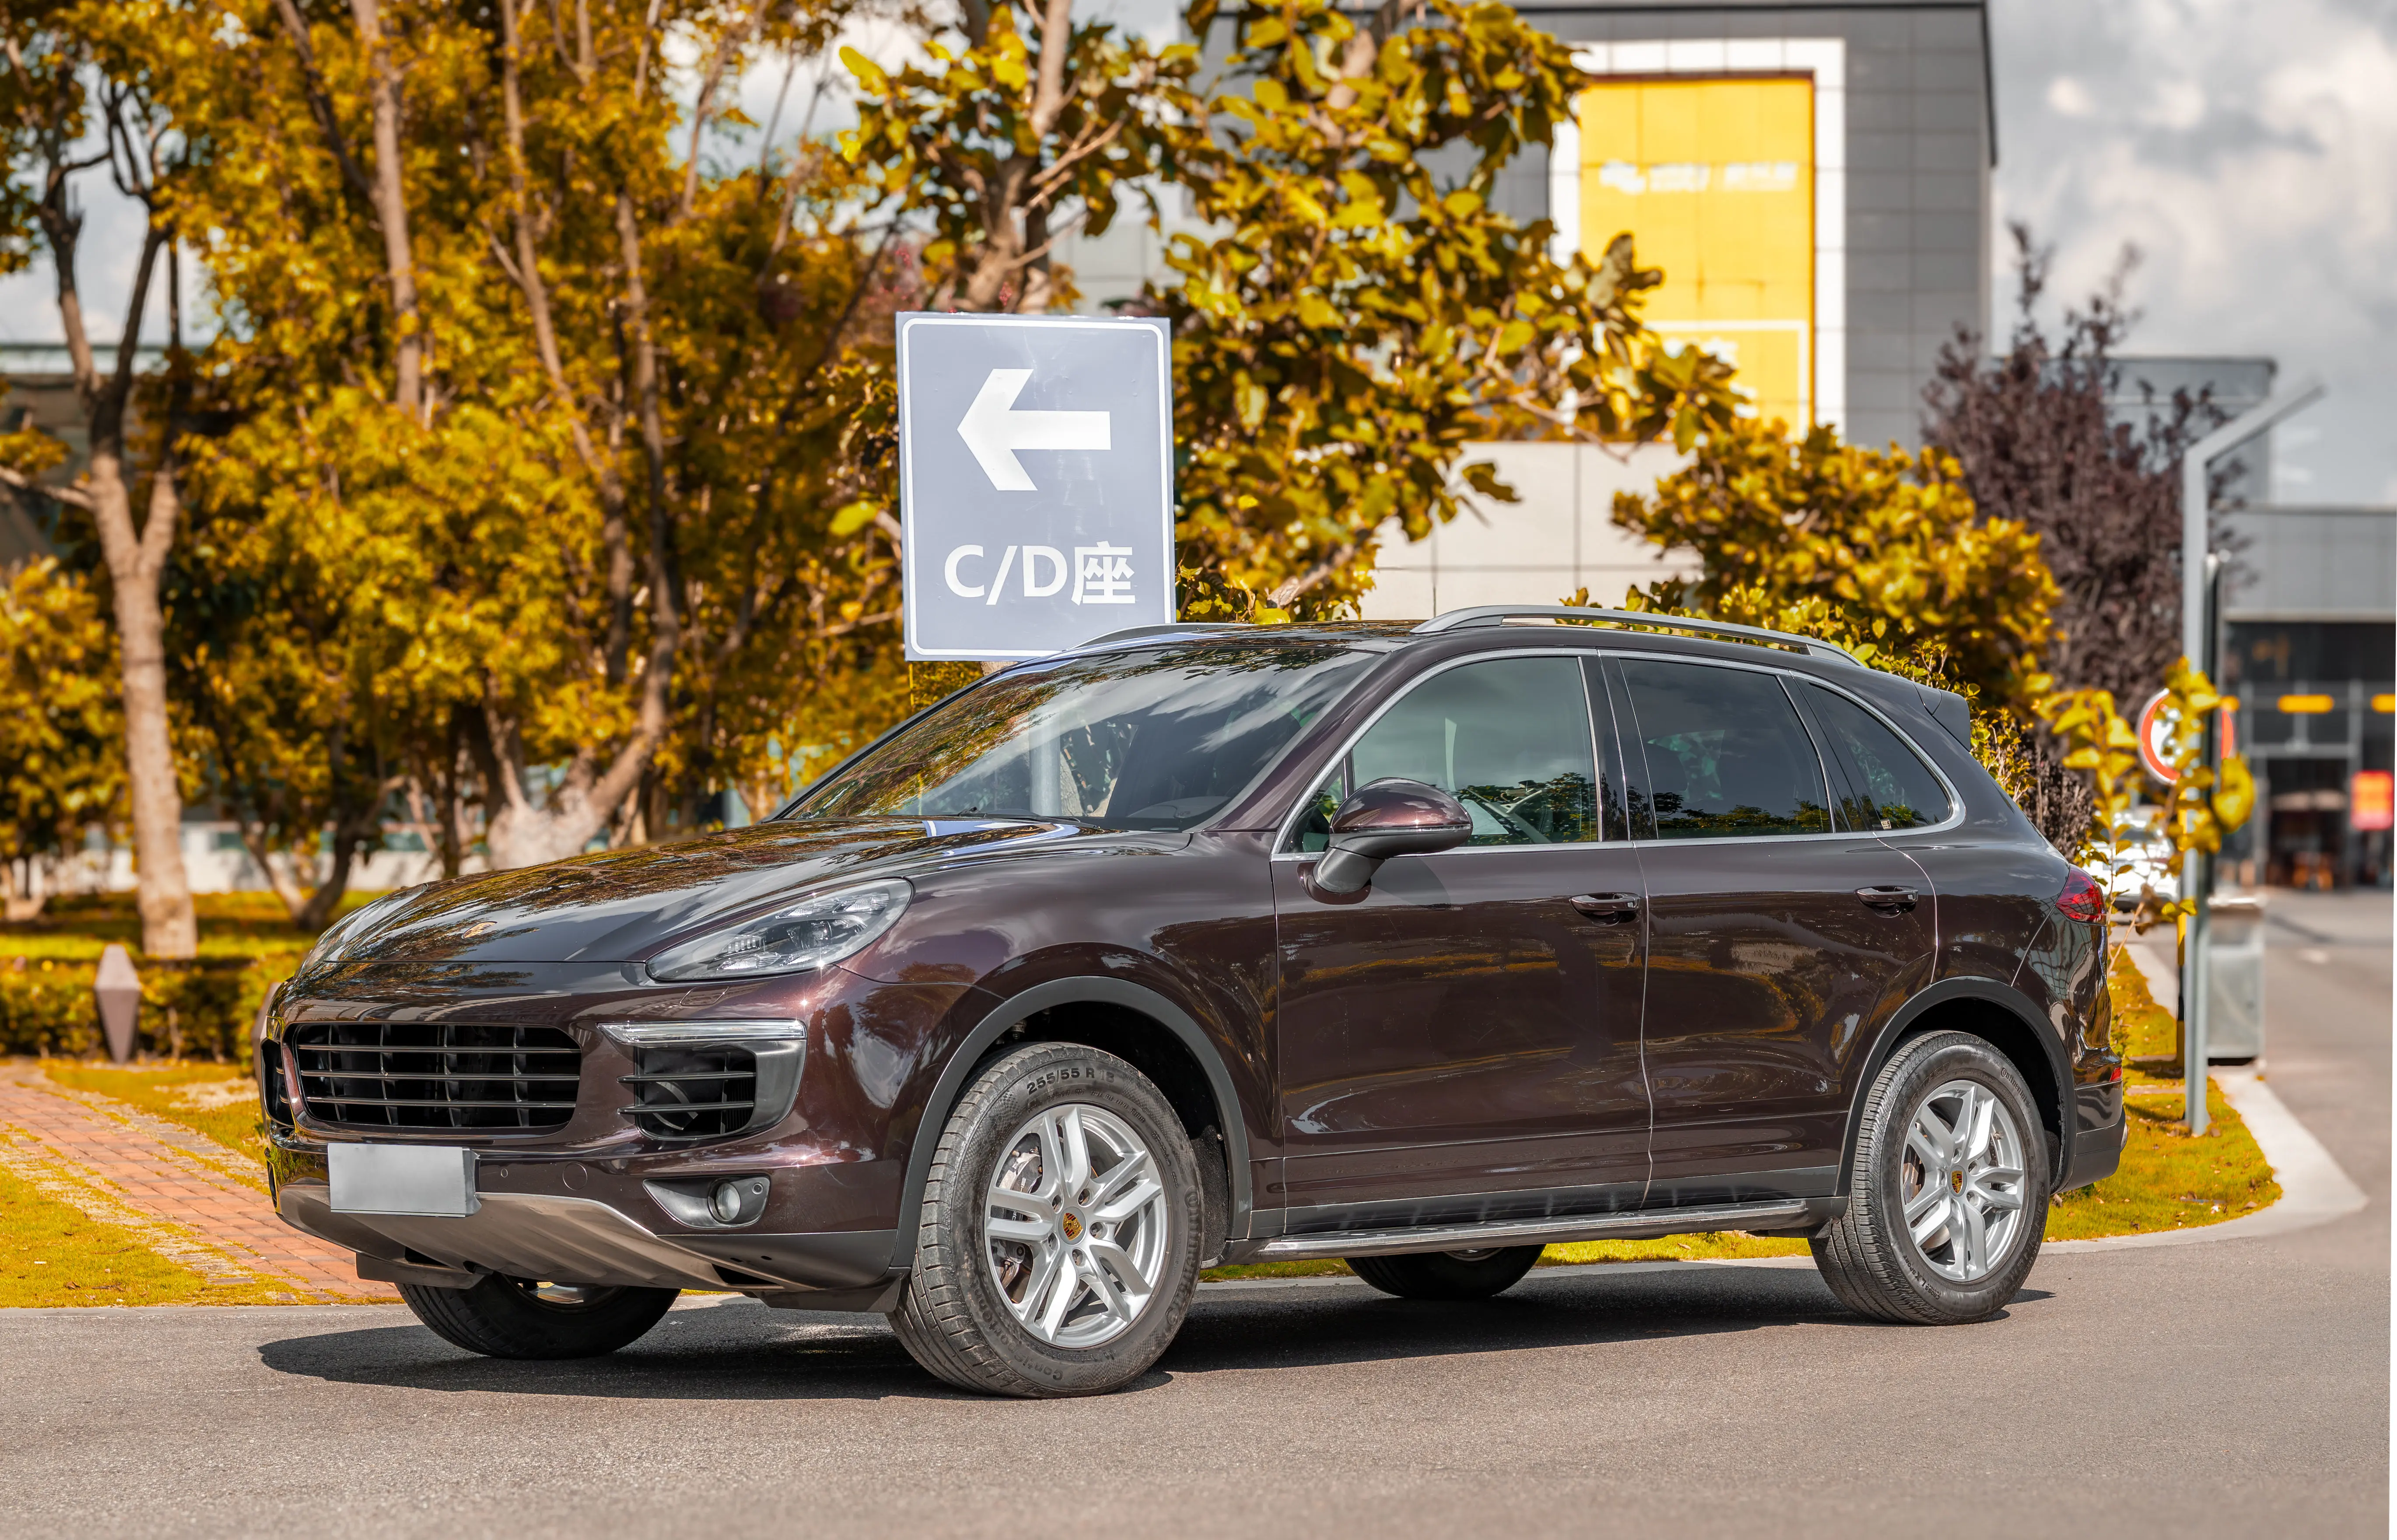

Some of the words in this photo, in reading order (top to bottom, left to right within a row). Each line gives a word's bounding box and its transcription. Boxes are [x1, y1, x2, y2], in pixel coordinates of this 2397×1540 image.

[944, 541, 1135, 606] C/D座
[1027, 1068, 1080, 1095] 255/55
[1085, 1068, 1095, 1078] R
[2001, 1067, 2027, 1102] Continental
[1903, 1254, 1917, 1275] SPORT
[1924, 1285, 1940, 1300] CROSS
